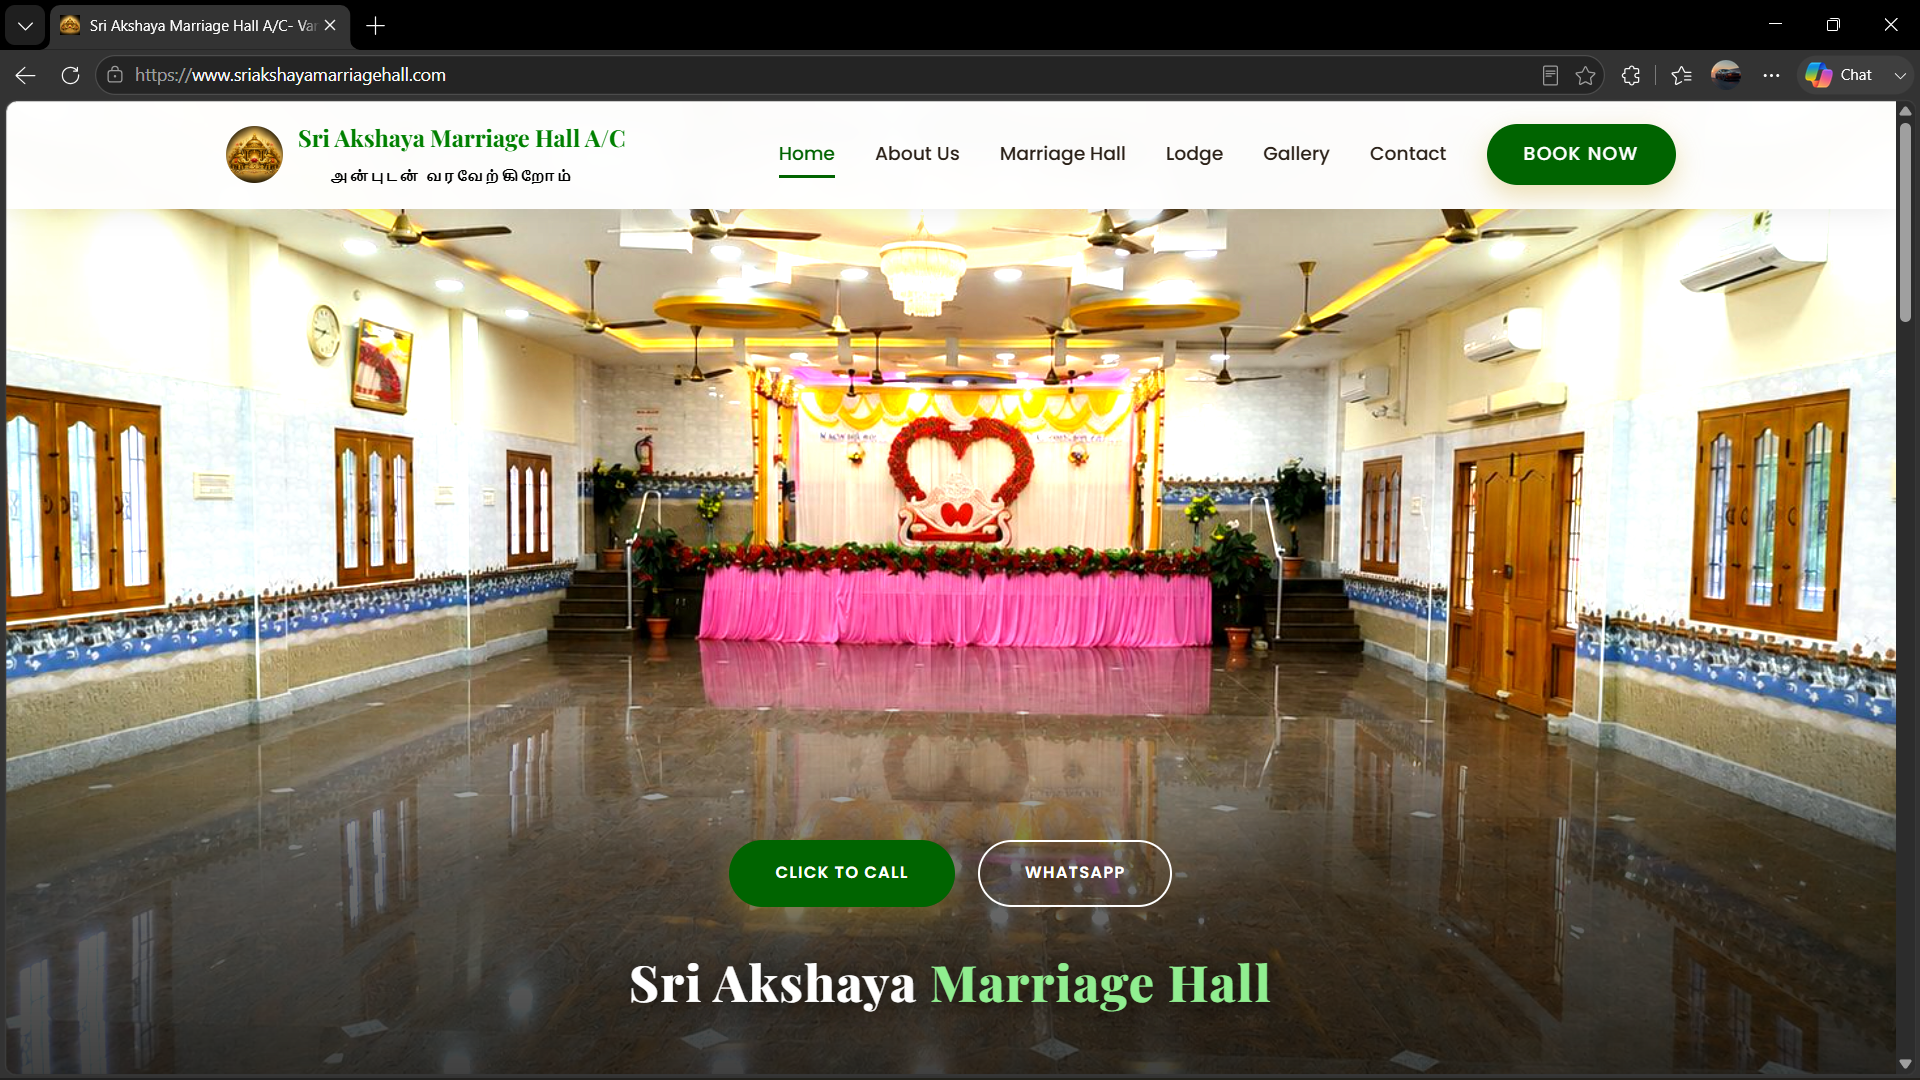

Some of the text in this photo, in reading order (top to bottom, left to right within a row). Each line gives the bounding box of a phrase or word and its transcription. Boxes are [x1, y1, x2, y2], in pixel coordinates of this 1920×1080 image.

[90, 19, 107, 32] Sri
[110, 19, 166, 35] Akshaya
[169, 19, 230, 35] Marriage
[233, 19, 259, 32] Hall
[262, 19, 294, 34] A/C-
[135, 66, 447, 86] https://www.sriakshayamarriagehall.com
[1840, 68, 1873, 81] Chat
[298, 128, 626, 153] Sri Akshaya Marriage Hall A/C
[779, 146, 835, 161] Home
[875, 145, 960, 161] About Us
[1000, 144, 1126, 166] Marriage Hall
[1166, 145, 1224, 166] Lodge
[1263, 145, 1331, 166] Gallery
[1369, 146, 1447, 161] Contact
[1523, 145, 1638, 162] BOOK NOW
[330, 168, 572, 185] அன்புடன் வரவேற்கிறோம்
[774, 865, 909, 880] CLICK TO CALL
[1025, 865, 1125, 880] WHATSAPP
[630, 962, 1271, 1013] Sri Akshaya Marriage Hall
